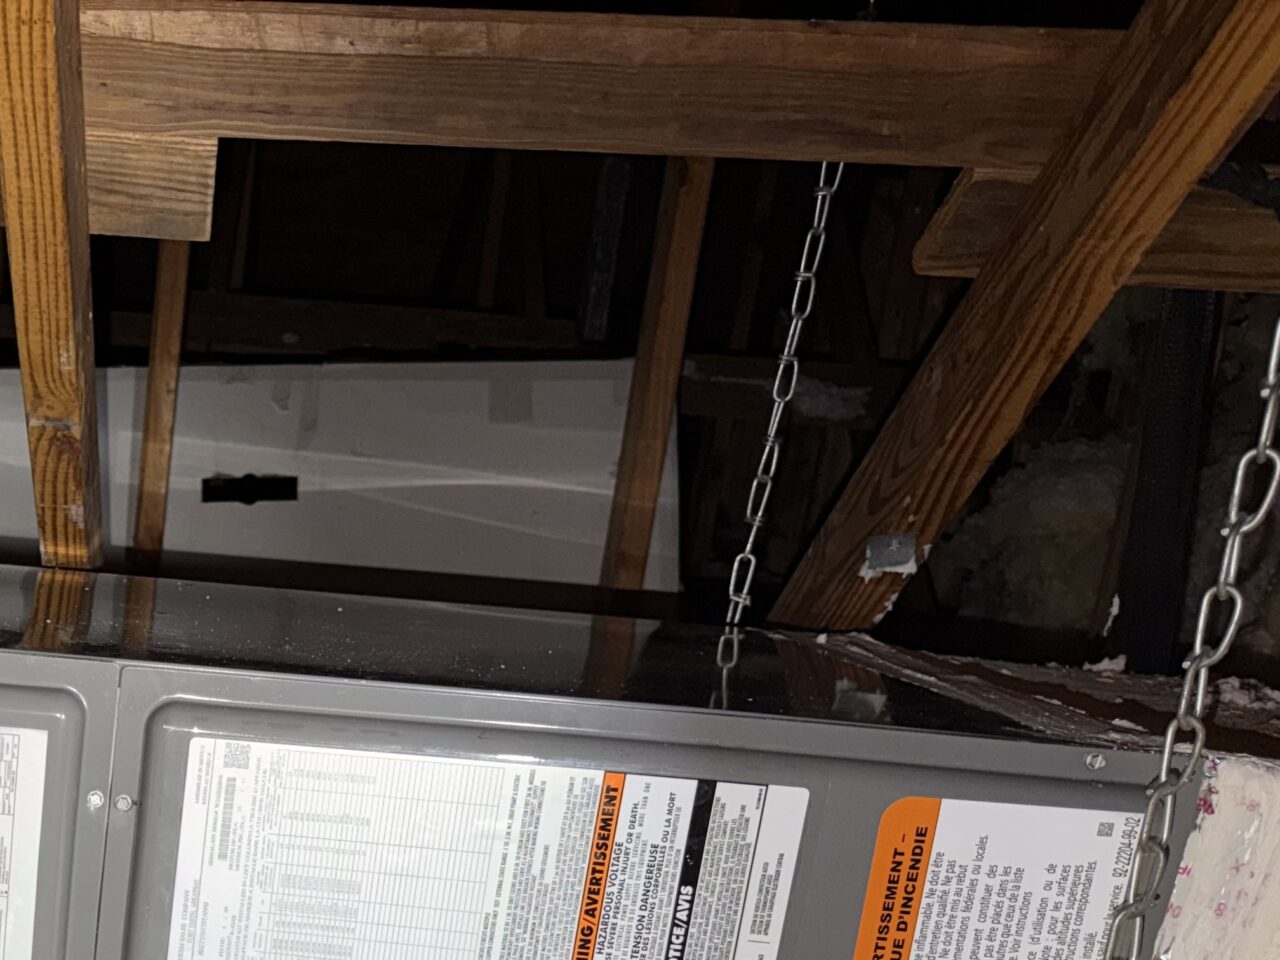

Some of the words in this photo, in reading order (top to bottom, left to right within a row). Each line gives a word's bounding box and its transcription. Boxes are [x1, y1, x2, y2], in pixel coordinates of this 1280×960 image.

[628, 801, 639, 829] DEATH.
[666, 792, 675, 815] MORT
[663, 817, 671, 827] LA
[625, 831, 633, 844] OR
[661, 830, 669, 843] OU
[620, 845, 630, 875] INJURY
[971, 864, 981, 875] ou
[984, 864, 998, 878] des
[1044, 863, 1057, 874] de
[650, 845, 666, 899] CORPORELLES
[896, 826, 927, 931] D'INCENDIE
[927, 869, 941, 886] doit
[924, 887, 938, 899] Ne
[1042, 880, 1053, 891] ou
[596, 891, 614, 954] HAZARDOUS
[607, 841, 623, 887] VOLTAGE
[611, 878, 625, 919] PERSONAL
[630, 914, 645, 958] TENSION
[639, 843, 658, 911] DANGEREUSE
[977, 883, 993, 923] constituer
[606, 922, 617, 949] SEVERE
[640, 936, 649, 951] DES
[969, 928, 983, 960] peuvent
